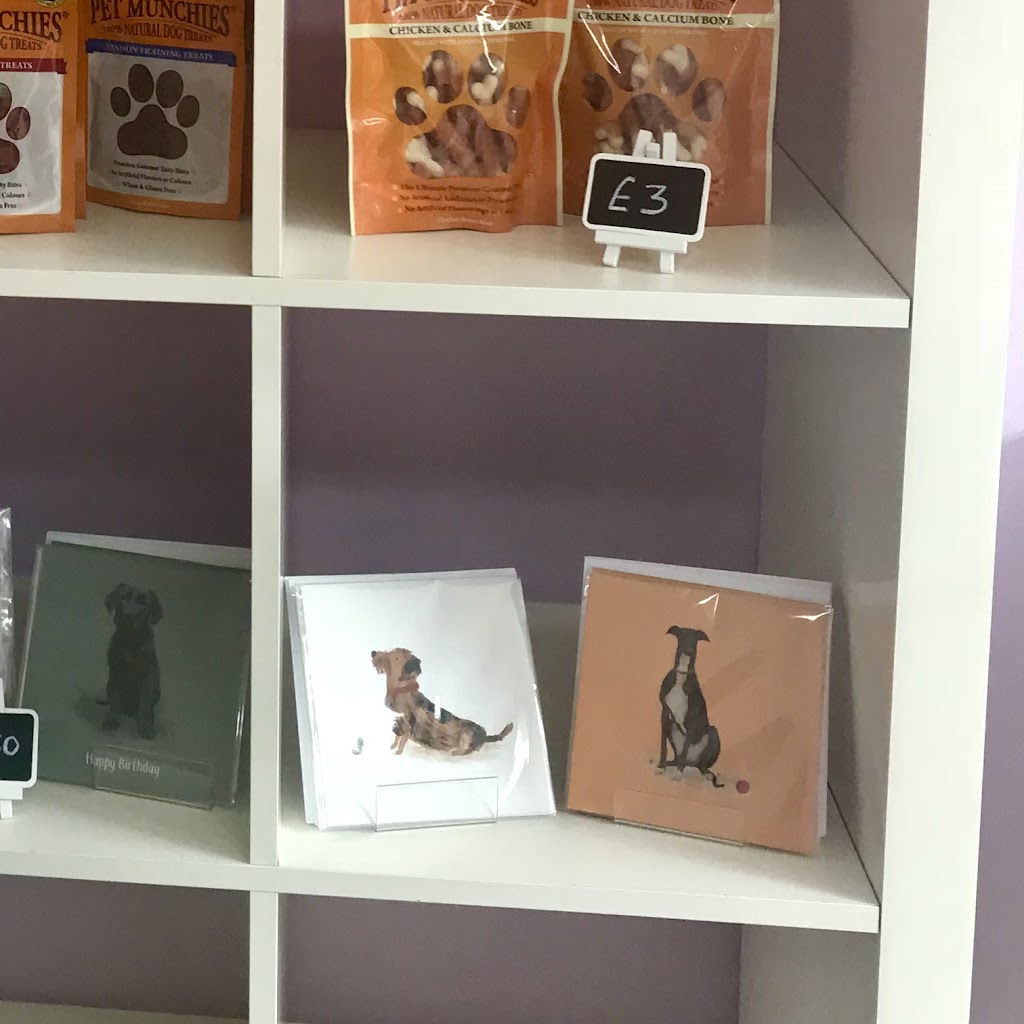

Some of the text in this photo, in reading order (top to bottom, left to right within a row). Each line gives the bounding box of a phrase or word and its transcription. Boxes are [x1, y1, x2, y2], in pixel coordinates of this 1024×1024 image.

[578, 10, 734, 26] CHICKEN & CALCIUM BONE
[125, 23, 162, 38] NATURAL
[163, 24, 182, 40] DOG
[389, 21, 532, 35] CHICKEN & BONE
[9, 37, 42, 51] TREATS
[139, 46, 182, 58] TRAINING
[183, 50, 214, 61] TREATS
[0, 61, 33, 70] TREATS
[608, 175, 669, 215] £3
[85, 751, 161, 777] Happy Birthday
